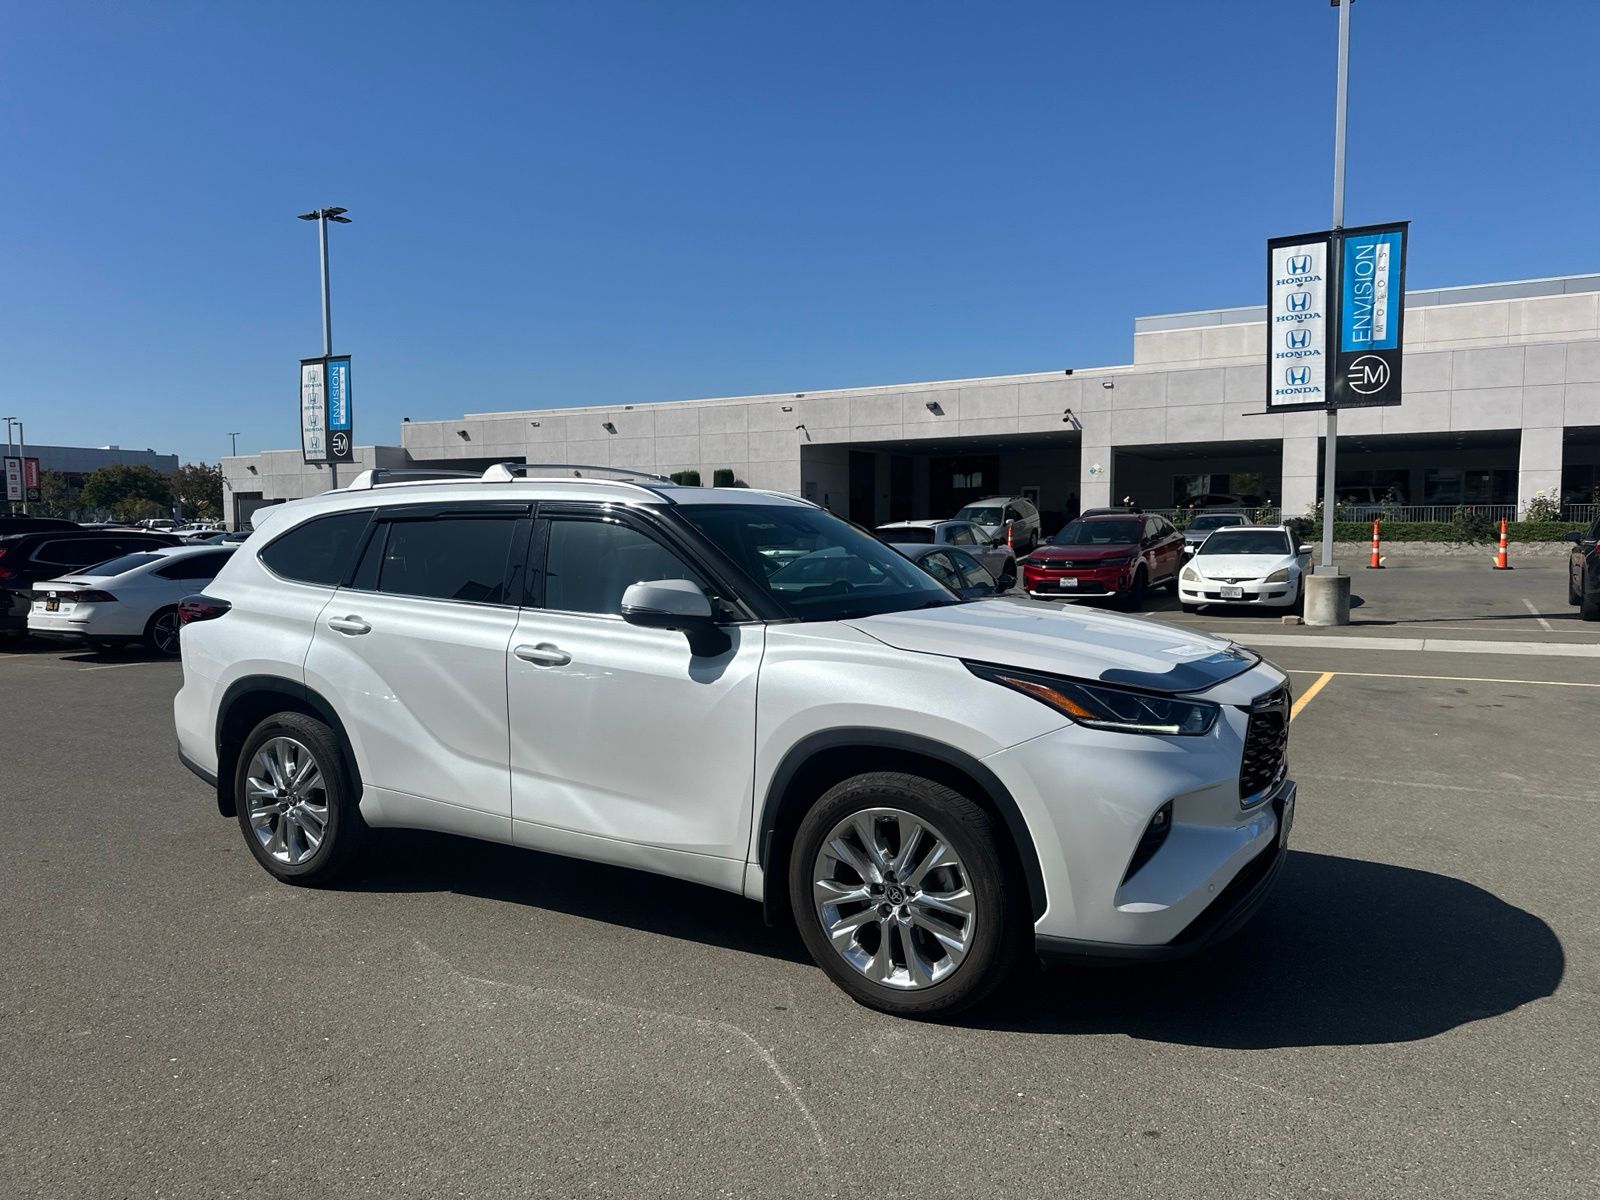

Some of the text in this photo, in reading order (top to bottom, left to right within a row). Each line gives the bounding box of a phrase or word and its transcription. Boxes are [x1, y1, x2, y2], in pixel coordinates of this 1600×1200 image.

[1276, 275, 1322, 286] HONDA
[1353, 244, 1375, 343] ENVISION
[1376, 252, 1387, 333] MOTORS
[1276, 313, 1322, 323] HONDA
[1276, 350, 1322, 359] HONDA
[332, 367, 340, 425] ENVISION
[1275, 387, 1321, 396] HONDA
